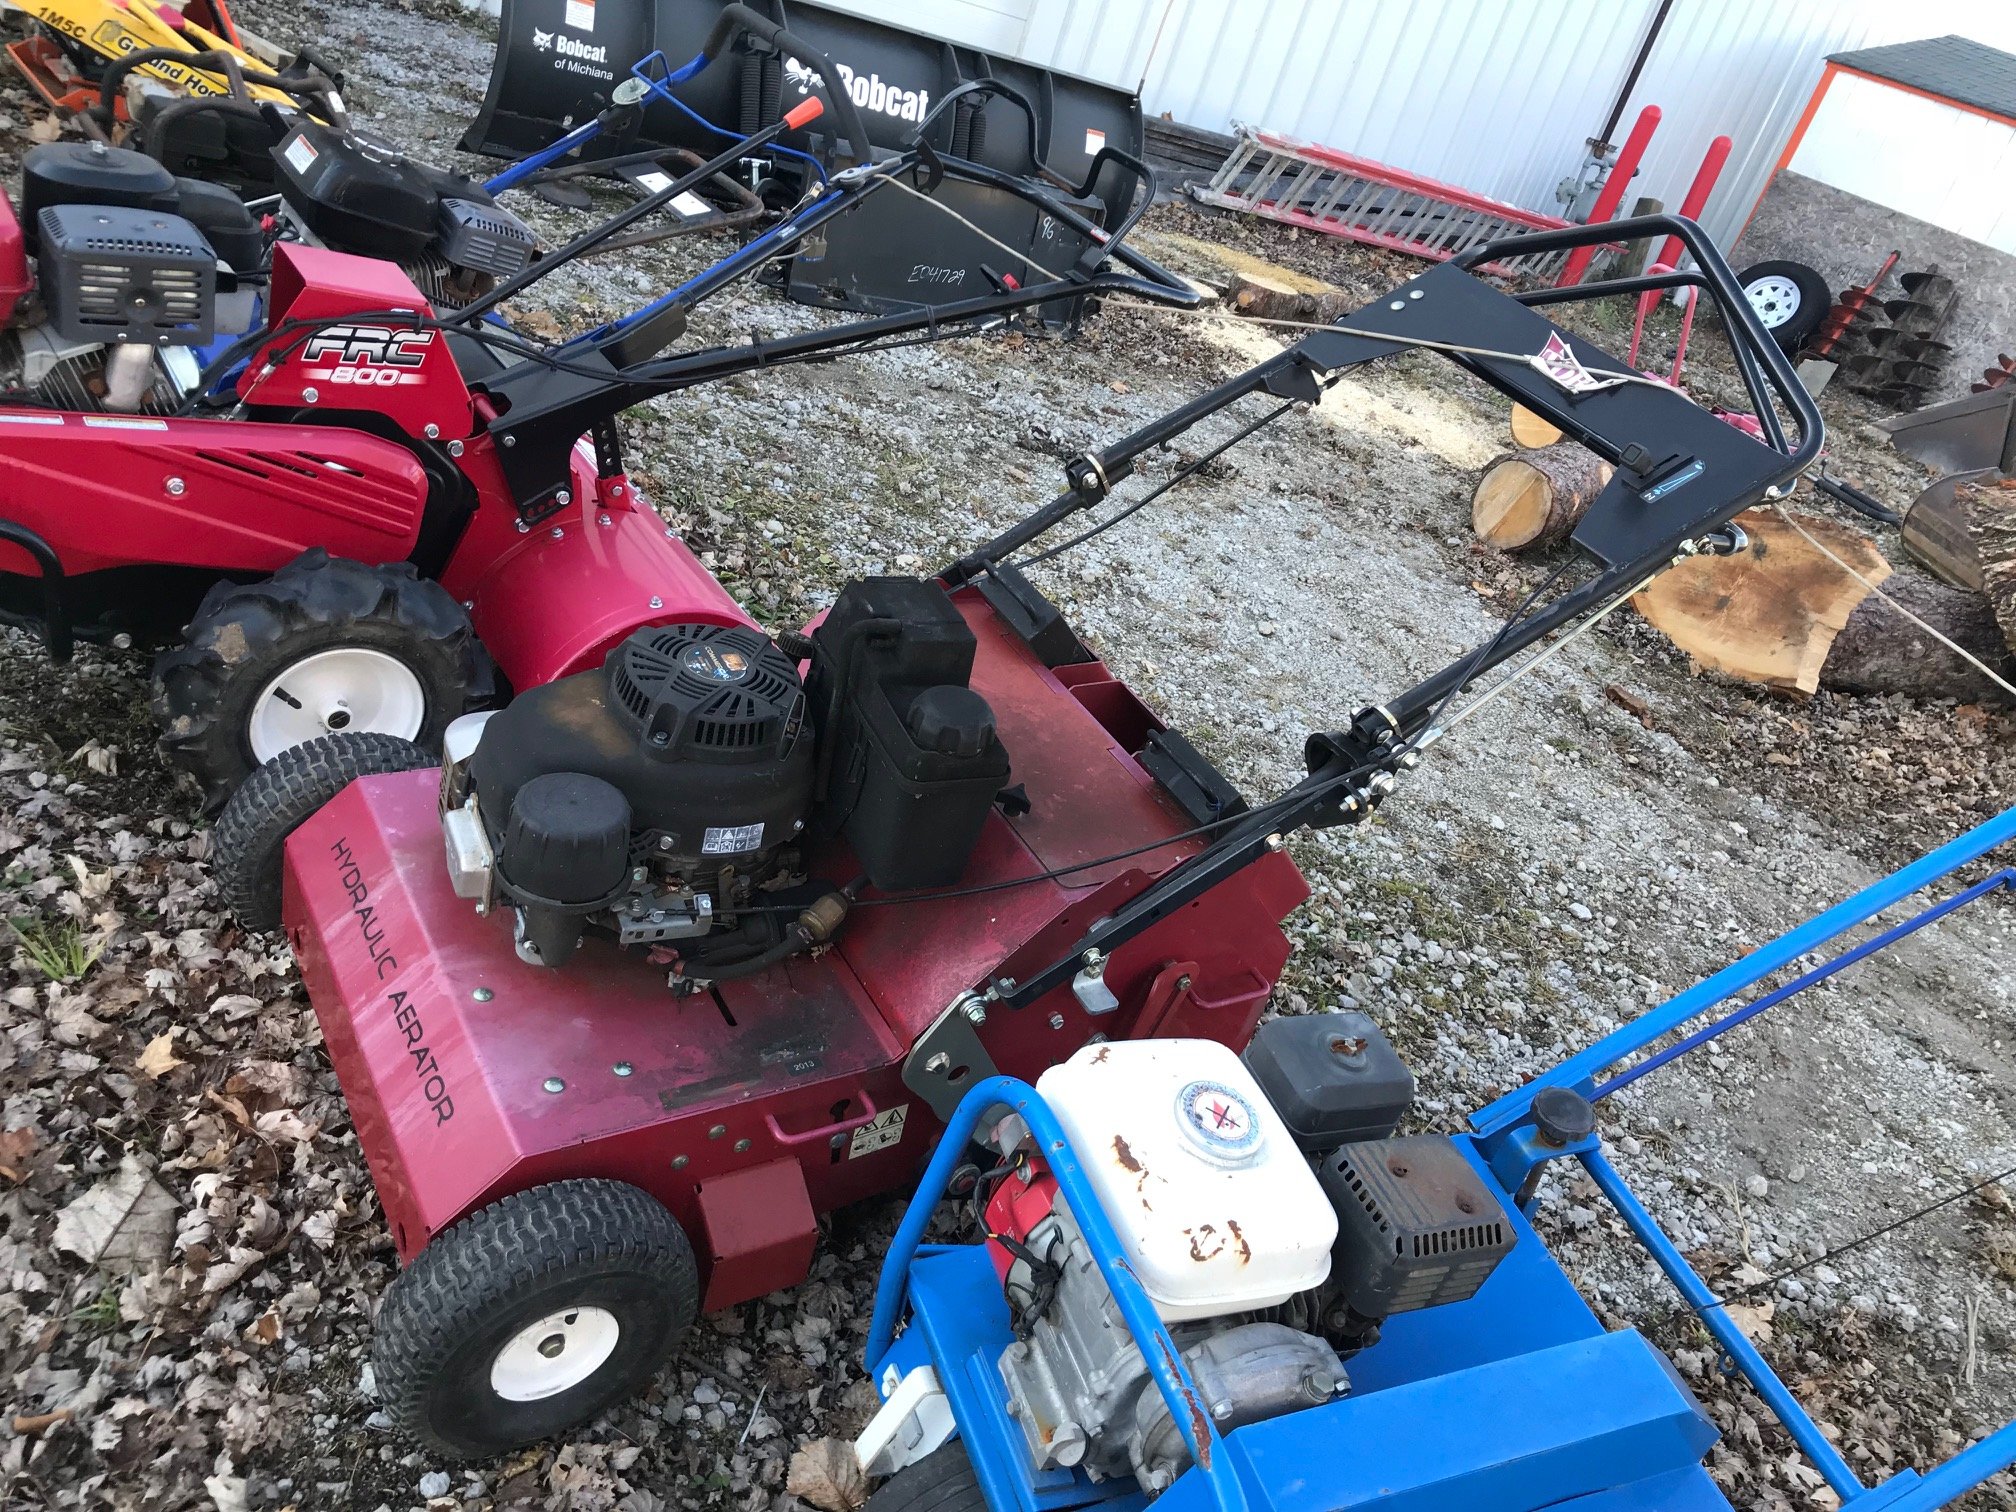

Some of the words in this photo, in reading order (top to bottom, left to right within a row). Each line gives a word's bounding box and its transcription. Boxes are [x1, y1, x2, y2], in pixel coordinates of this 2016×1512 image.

[38, 7, 87, 39] 1M5C
[554, 59, 567, 69] of
[567, 60, 614, 80] Michiana
[301, 324, 436, 368] FRC
[330, 366, 402, 386] 800
[330, 837, 397, 980] HYDRAULIC
[387, 990, 455, 1128] AERATOR
[793, 1060, 815, 1071] 2013
